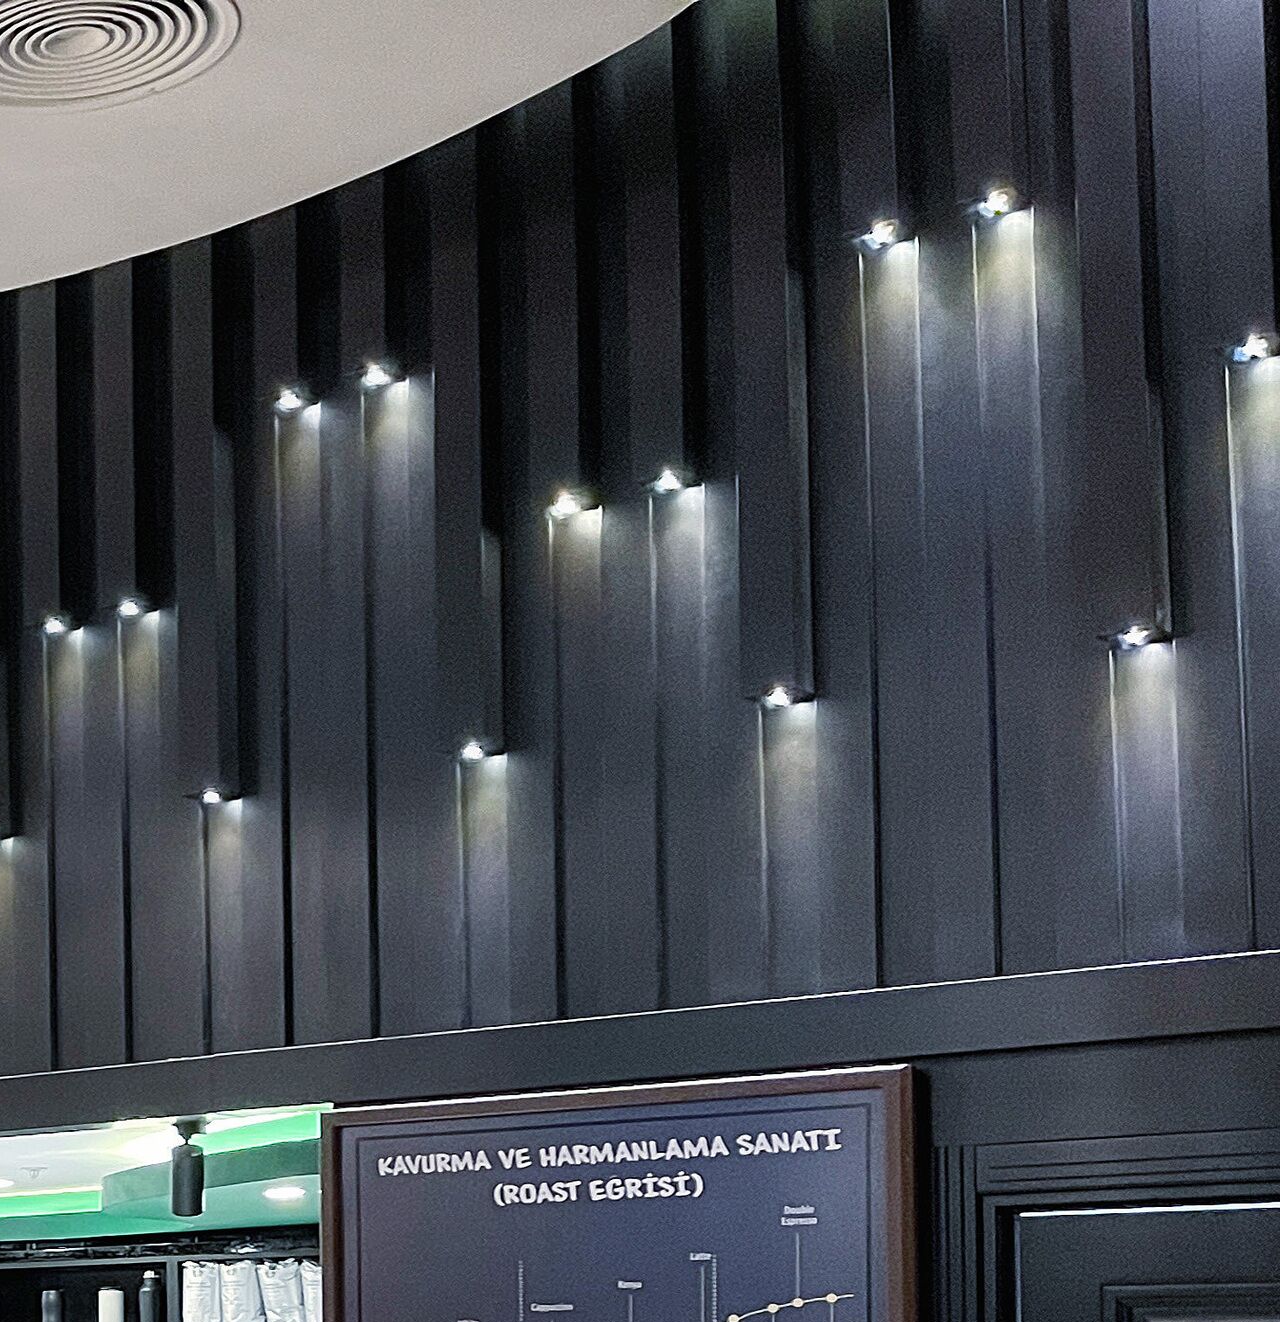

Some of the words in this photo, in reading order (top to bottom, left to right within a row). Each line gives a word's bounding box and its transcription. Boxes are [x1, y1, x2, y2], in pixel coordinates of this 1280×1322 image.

[377, 1149, 492, 1177] KAVURMA
[498, 1147, 532, 1170] VE
[539, 1135, 730, 1168] HARMANLAMA
[738, 1128, 842, 1158] SANATI
[493, 1179, 581, 1207] (ROAST
